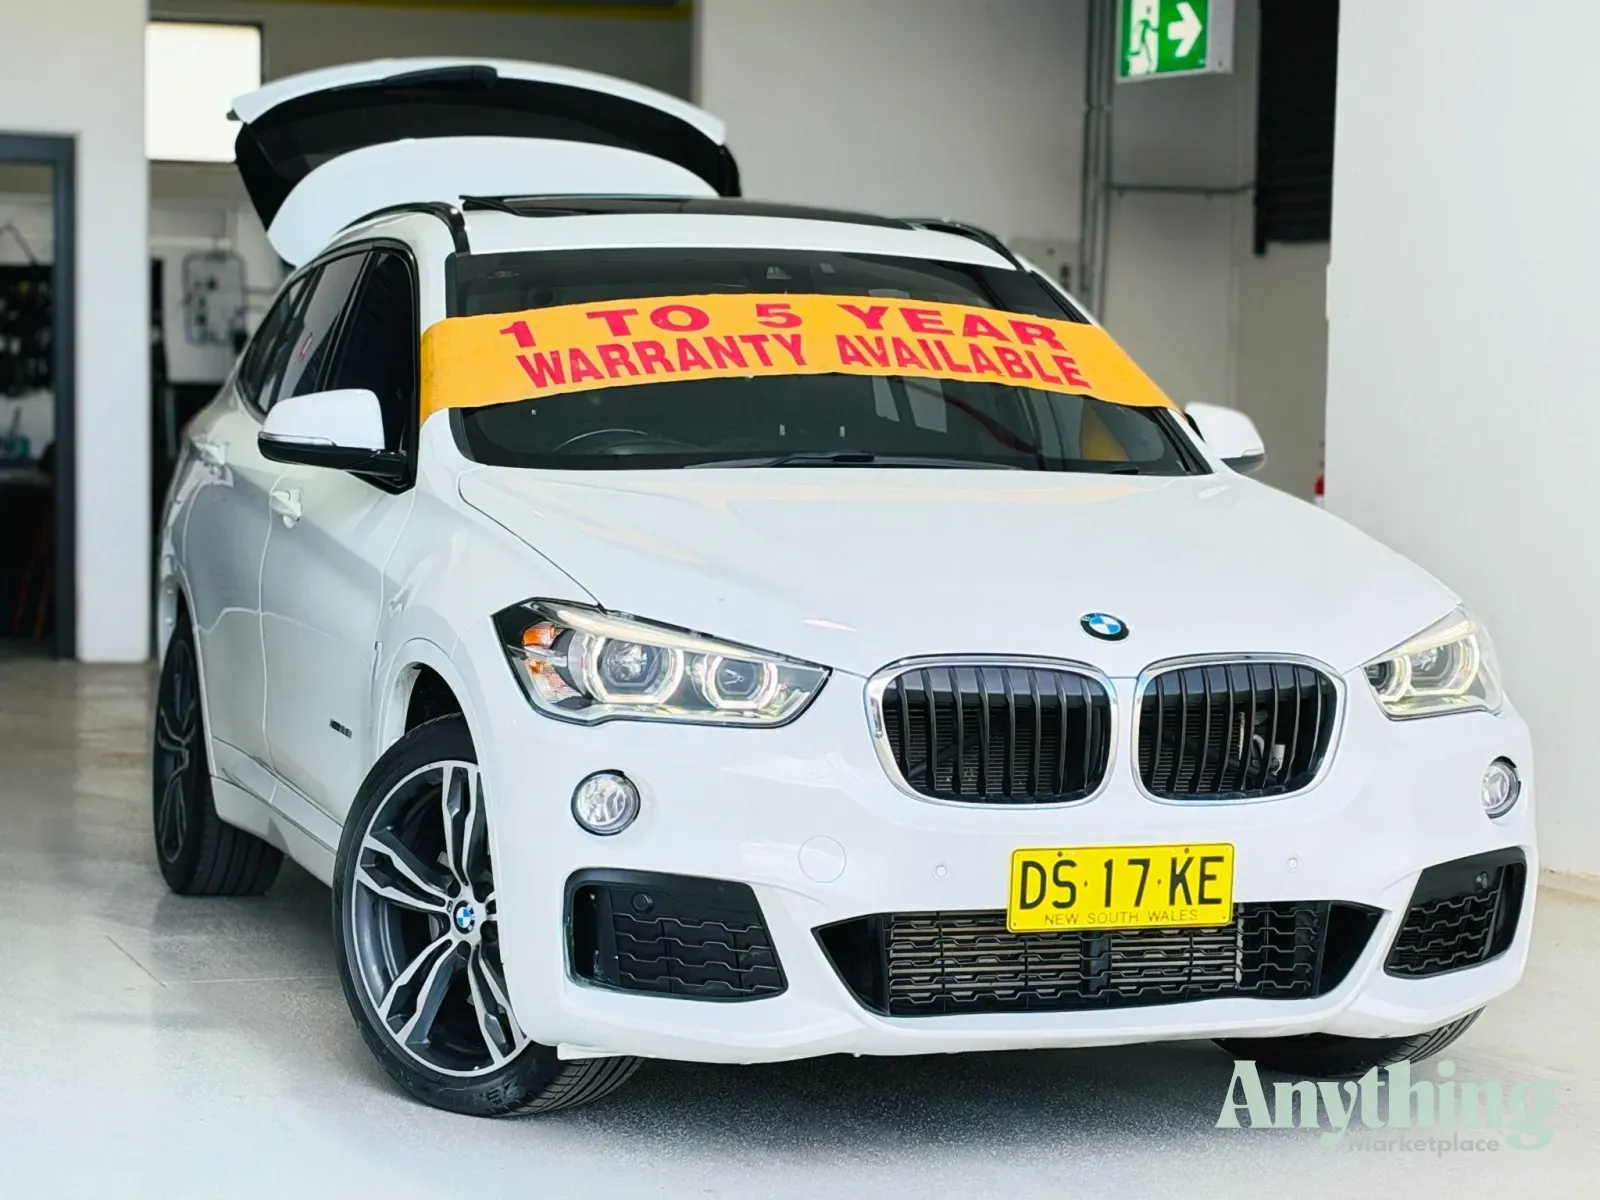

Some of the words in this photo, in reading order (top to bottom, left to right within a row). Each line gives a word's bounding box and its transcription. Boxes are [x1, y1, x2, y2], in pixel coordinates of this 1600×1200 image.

[500, 320, 536, 348] 1
[586, 304, 710, 337] TO
[755, 303, 803, 329] 5
[836, 304, 1067, 350] YEAR
[516, 333, 807, 389] WARRANTY
[835, 335, 1092, 389] AVAILABLE
[1044, 912, 1080, 926] NEW
[1087, 911, 1139, 924] SOUTH
[1147, 909, 1199, 923] WALES
